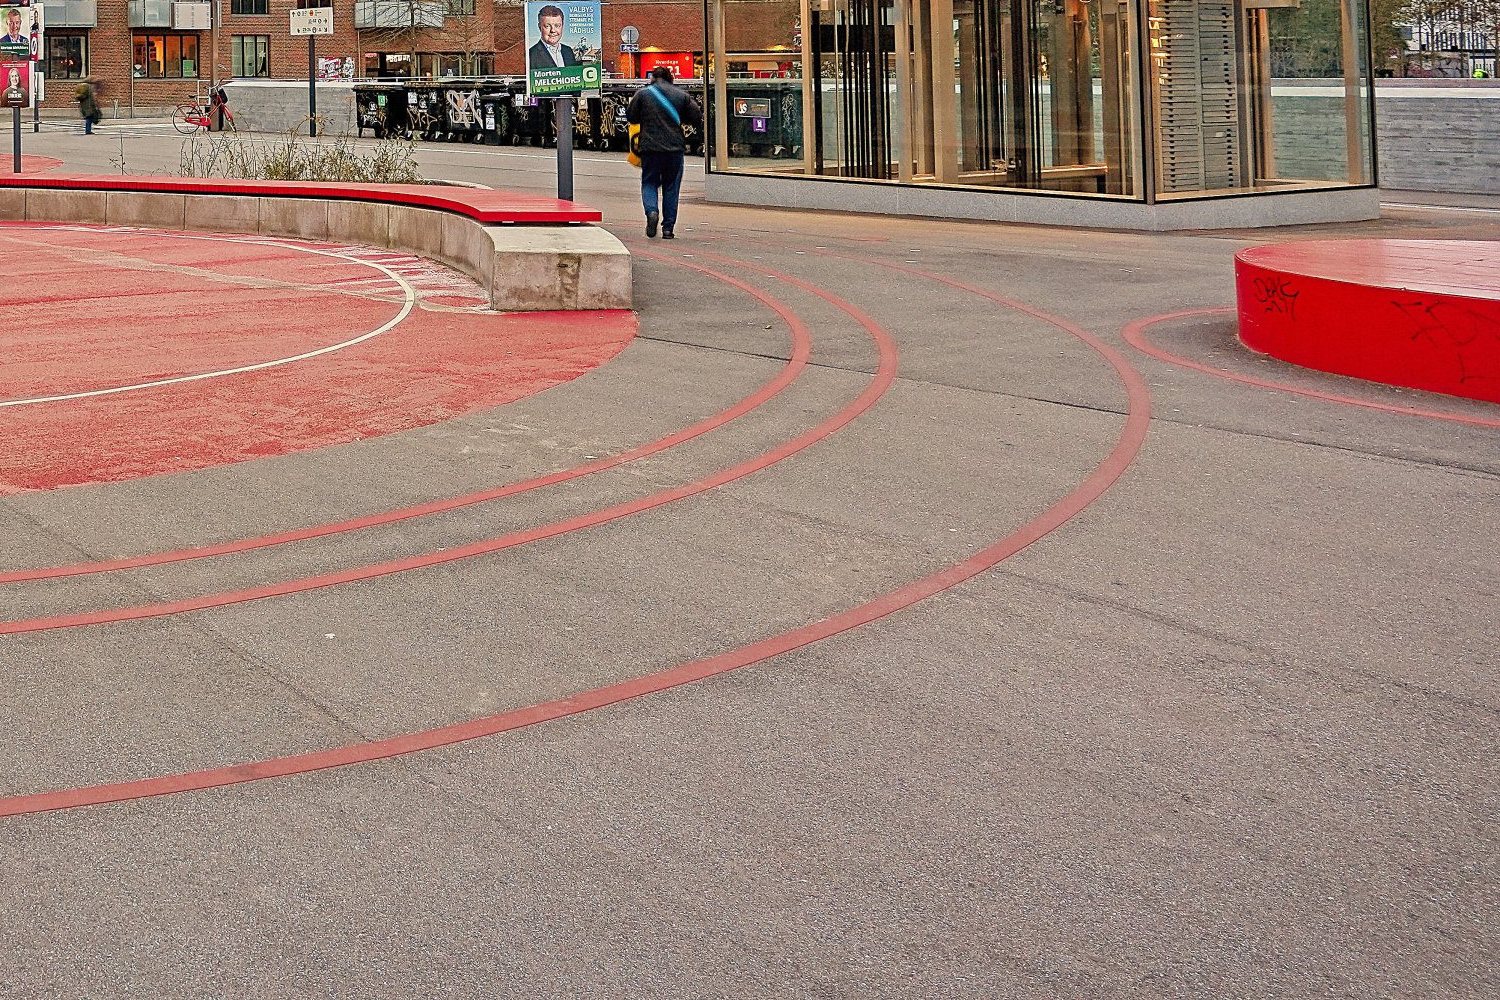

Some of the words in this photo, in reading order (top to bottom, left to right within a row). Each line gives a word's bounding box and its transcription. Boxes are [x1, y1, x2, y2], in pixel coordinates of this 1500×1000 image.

[569, 26, 595, 34] RÅDHUS
[534, 70, 561, 78] Morten
[534, 76, 581, 87] MELCHIORS
